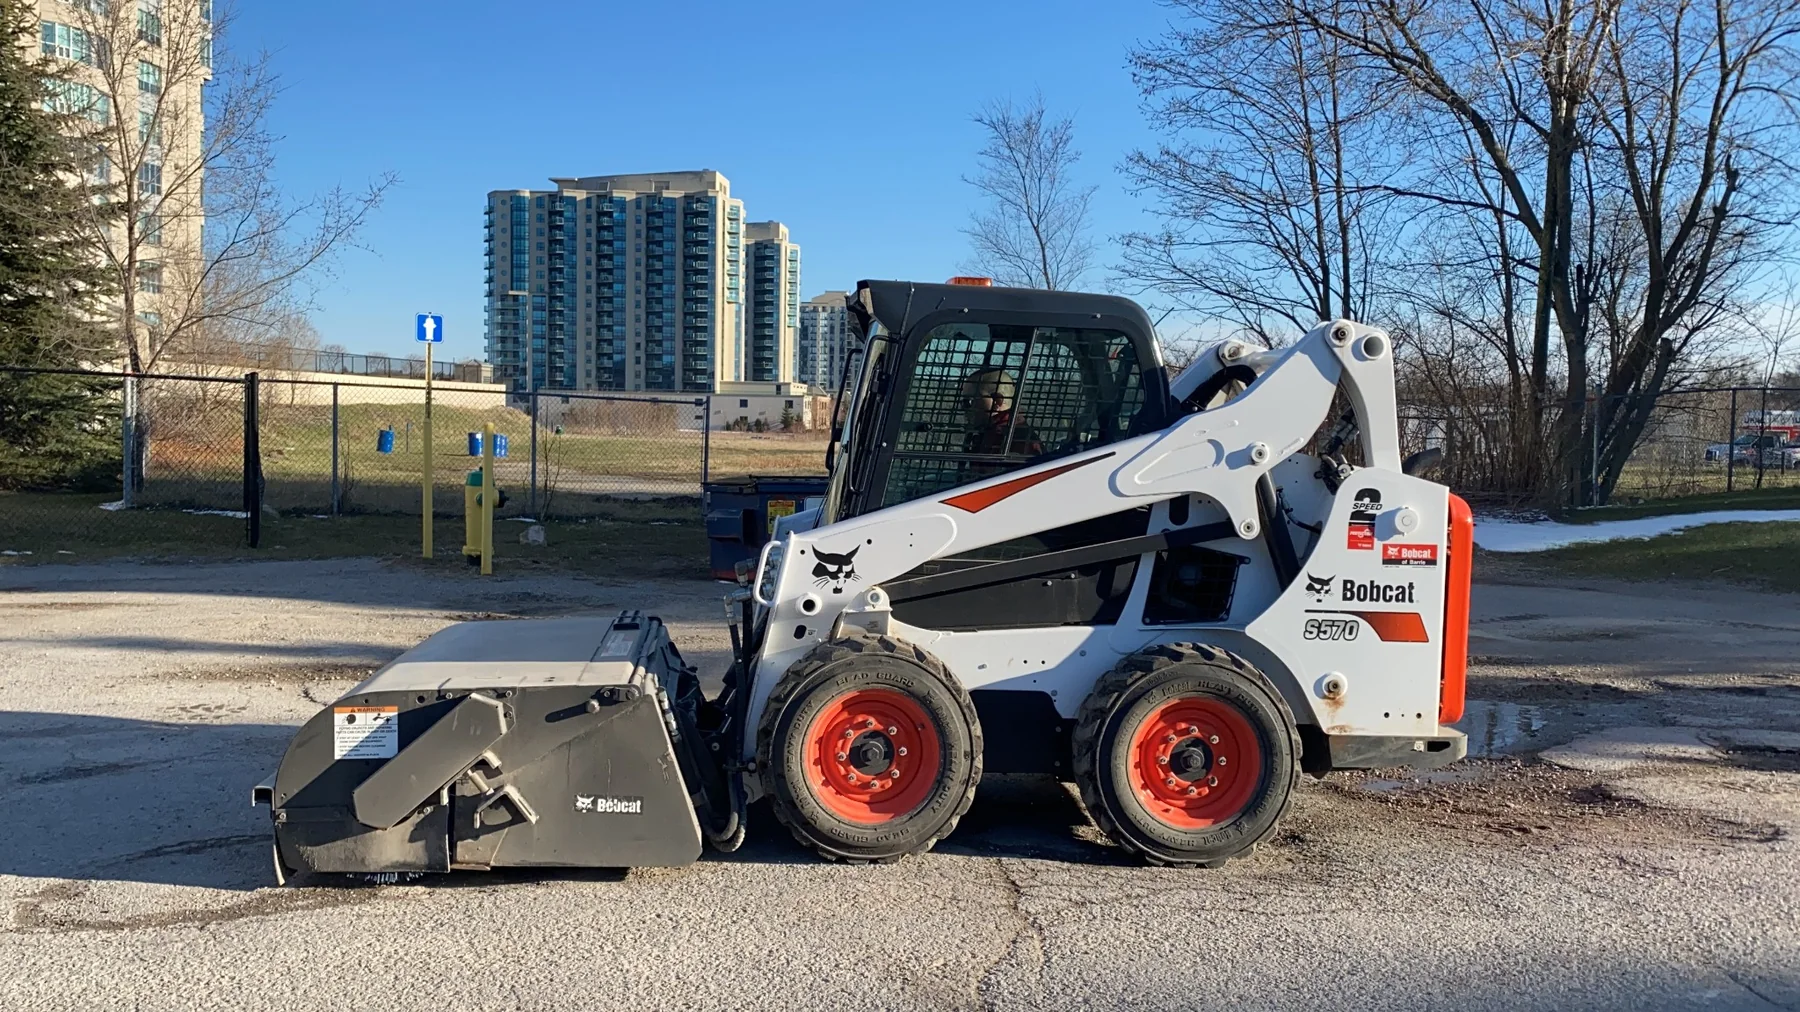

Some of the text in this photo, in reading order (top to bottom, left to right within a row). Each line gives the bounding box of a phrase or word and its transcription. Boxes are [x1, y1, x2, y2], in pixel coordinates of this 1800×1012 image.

[1349, 488, 1381, 520] 2
[1352, 502, 1383, 511] SPEED
[1401, 547, 1432, 559] Bobcat
[1342, 579, 1415, 603] Bobcat
[1303, 618, 1360, 641] S570
[596, 798, 642, 813] Bobcat
